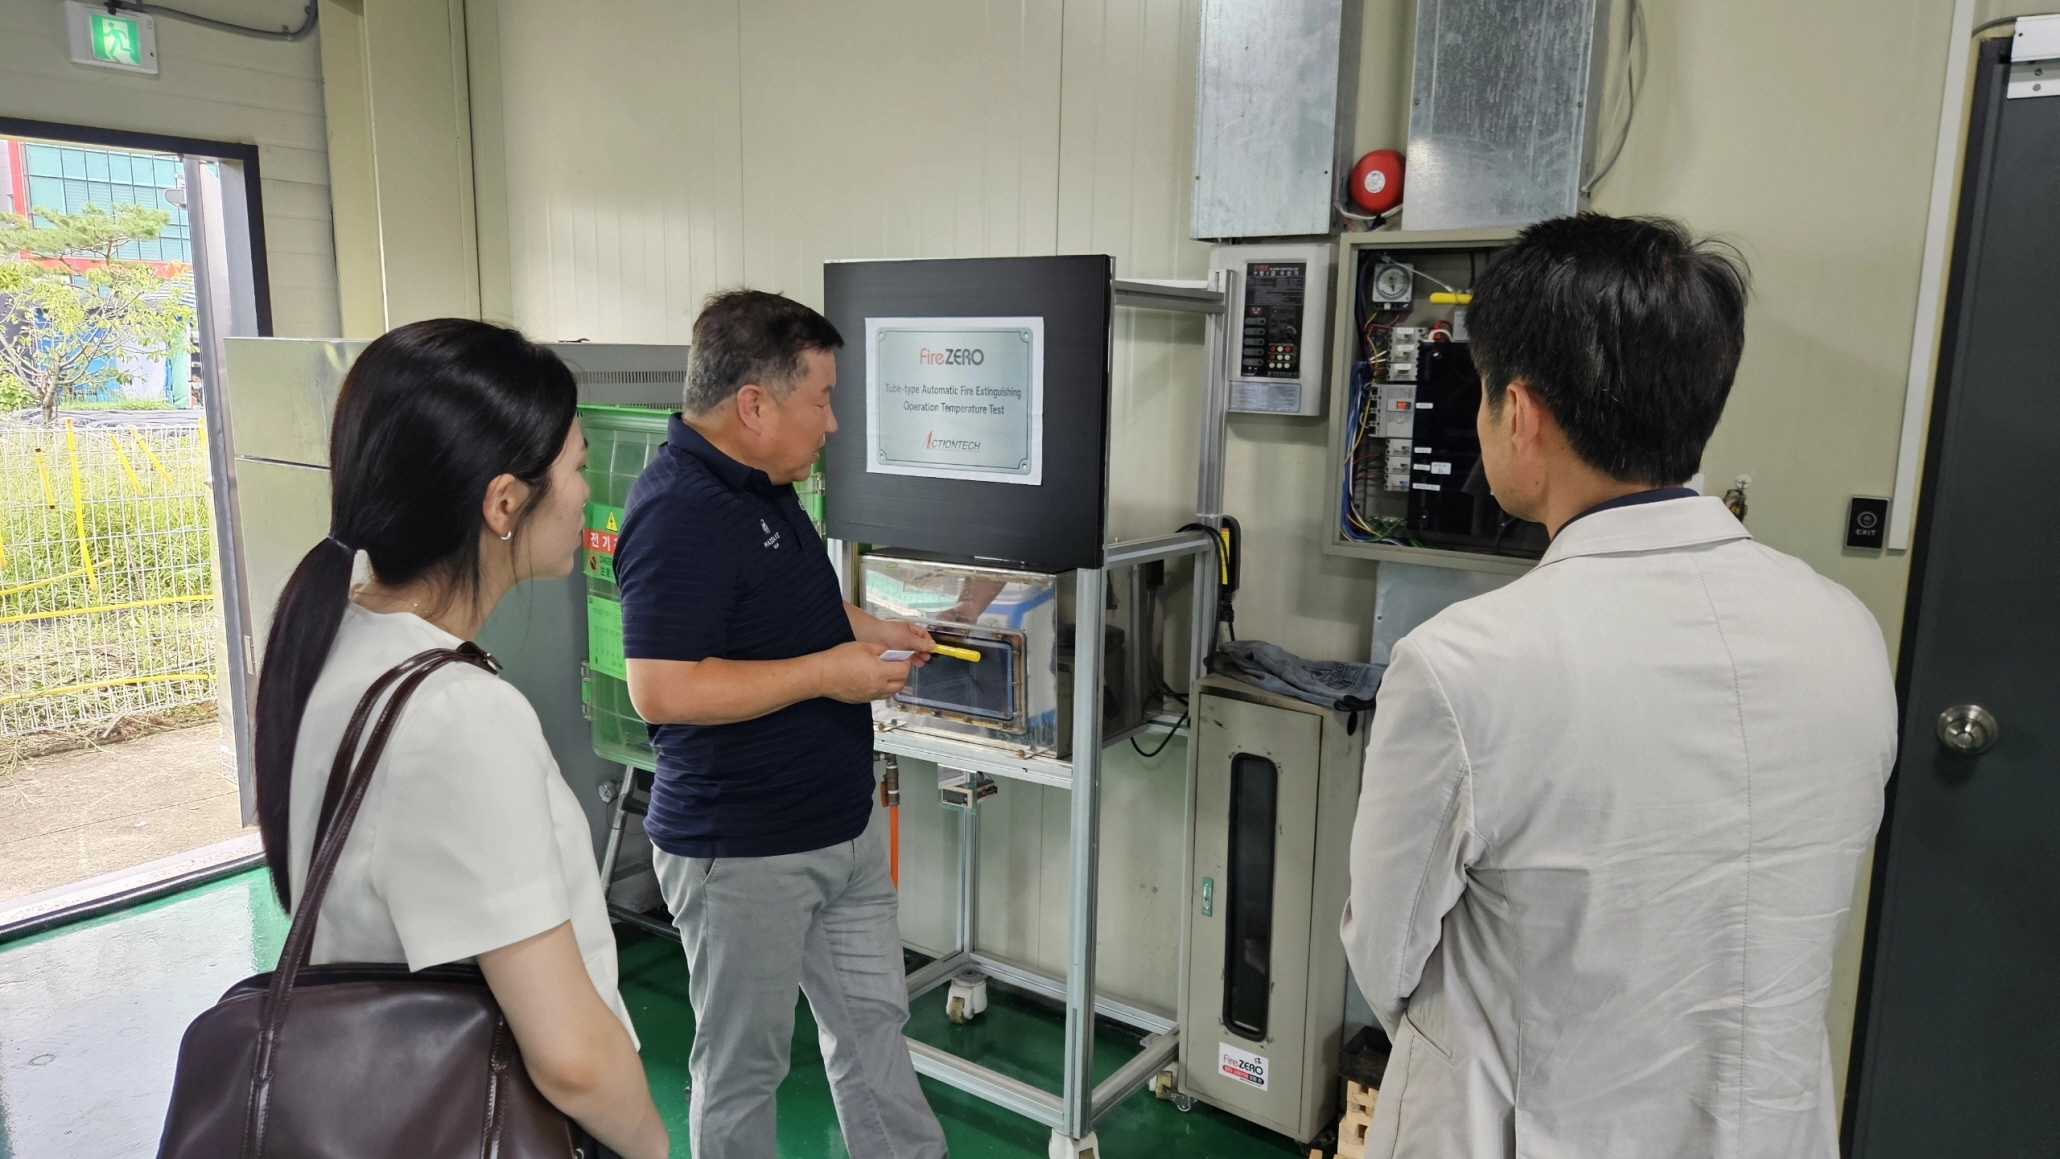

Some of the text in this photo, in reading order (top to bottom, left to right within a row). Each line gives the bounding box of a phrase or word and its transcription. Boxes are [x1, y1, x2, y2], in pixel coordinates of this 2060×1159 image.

[919, 347, 984, 366] FireZERO
[885, 383, 1022, 400] Tube-type Automatic Fire Extinguishing
[903, 400, 1005, 415] Operation Temperature Test
[1856, 529, 1877, 537] EXIT
[1223, 1053, 1264, 1076] FireZERO
